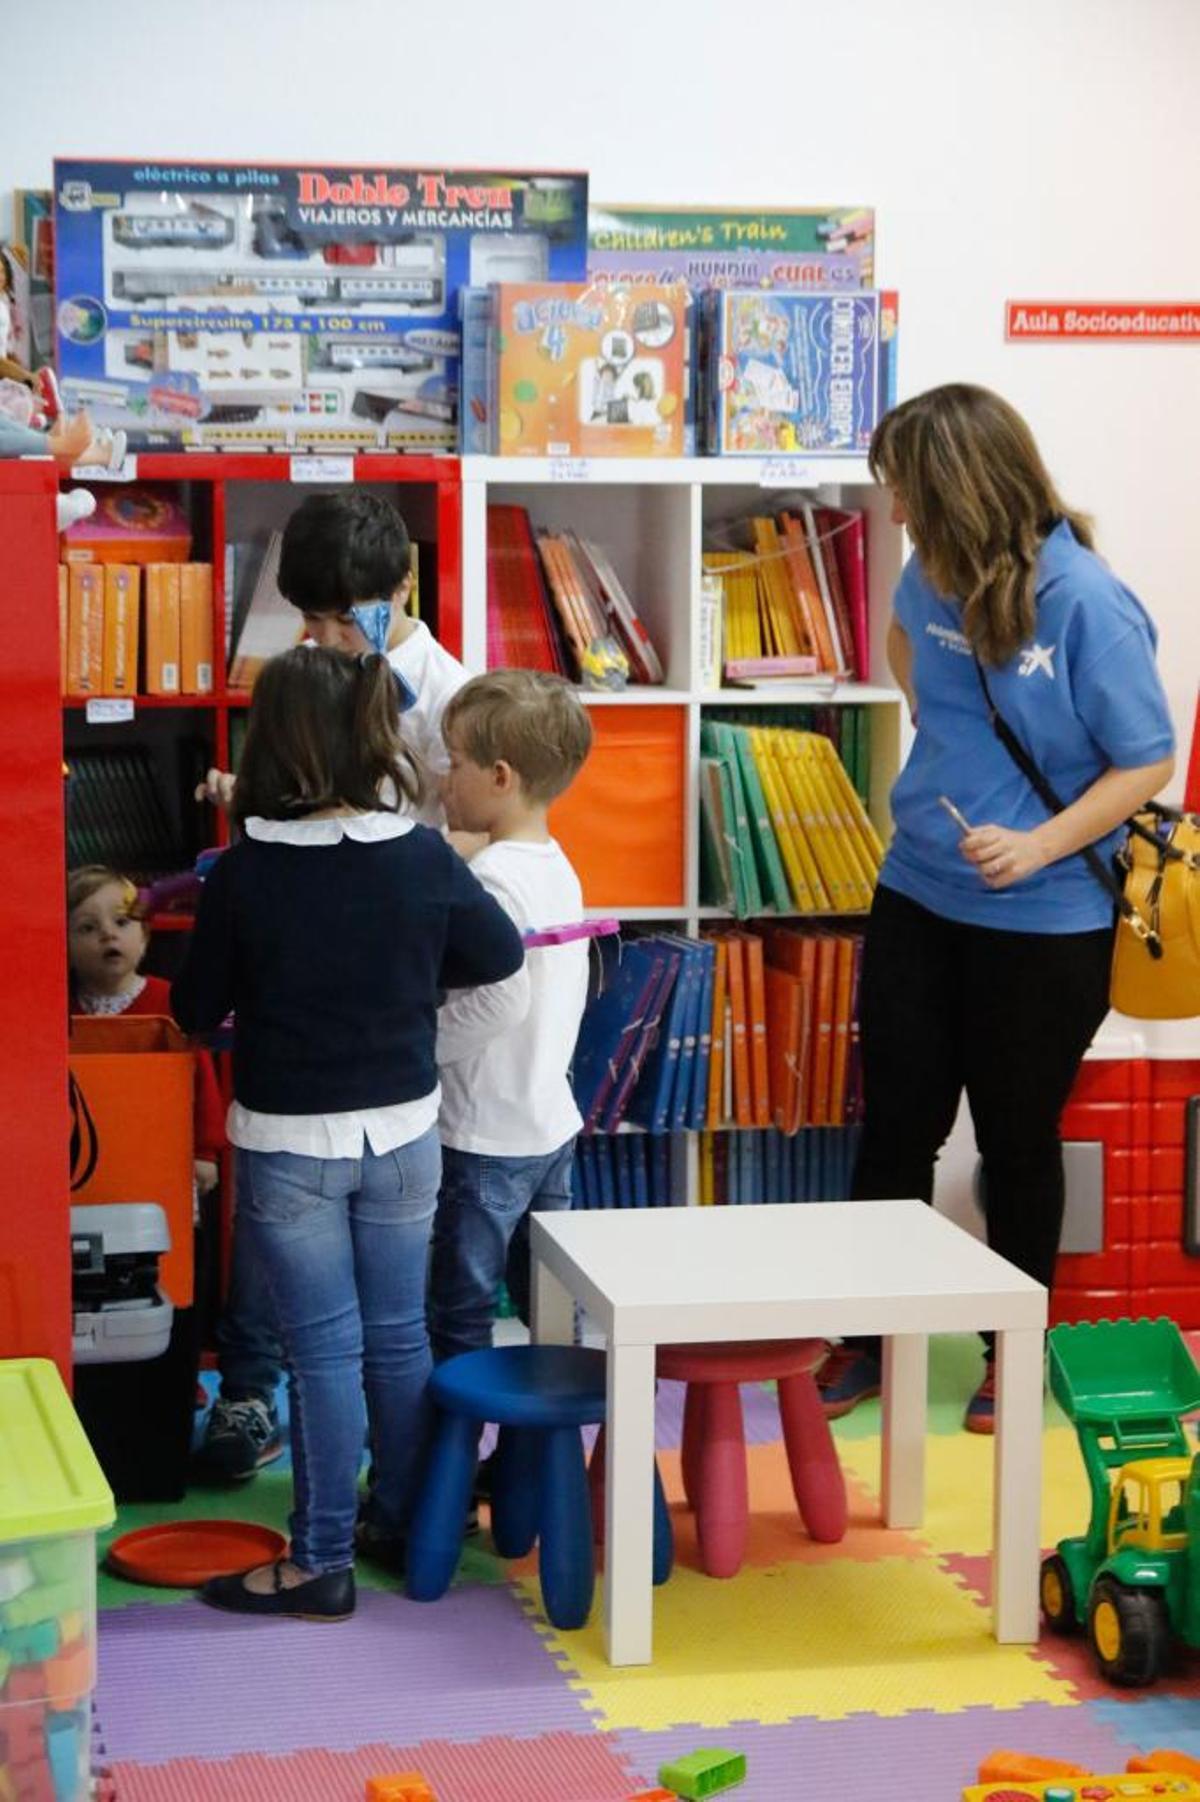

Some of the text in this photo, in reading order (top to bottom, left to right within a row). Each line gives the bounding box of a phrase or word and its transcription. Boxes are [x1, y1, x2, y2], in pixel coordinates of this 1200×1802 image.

[234, 168, 280, 186] pilas
[296, 172, 514, 209] Doble Tren
[298, 208, 513, 229] VIAJEROS Y MERCANCÍAS
[719, 217, 788, 241] Train
[318, 317, 353, 331] 100
[357, 319, 386, 333] cm
[1012, 309, 1060, 331] Aula
